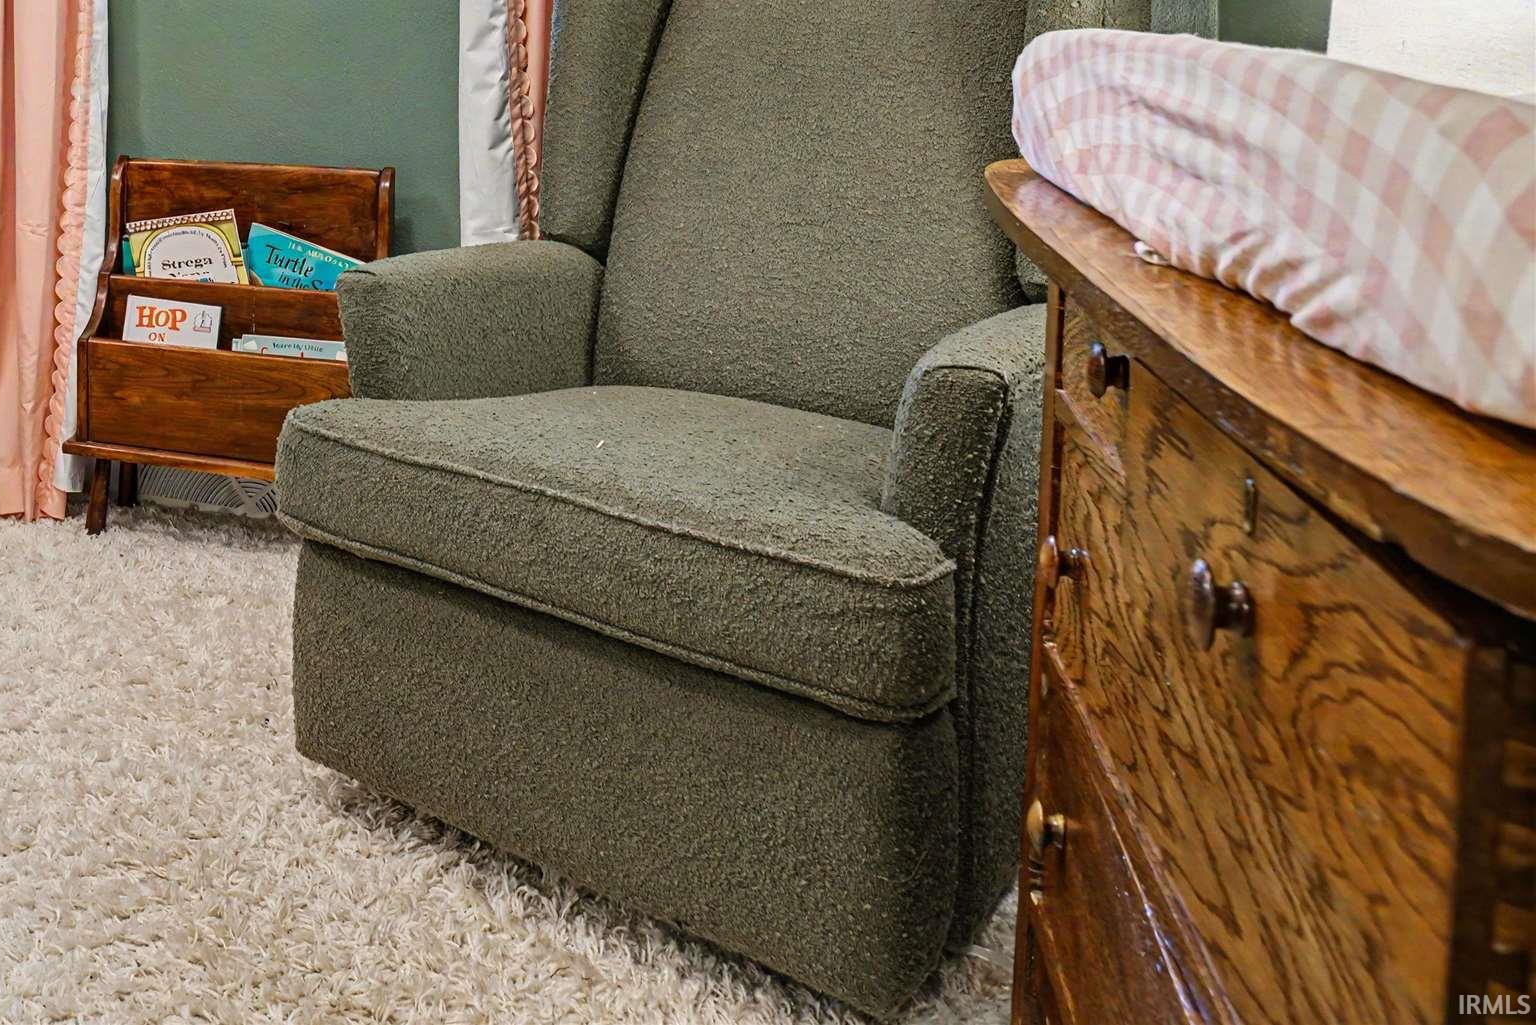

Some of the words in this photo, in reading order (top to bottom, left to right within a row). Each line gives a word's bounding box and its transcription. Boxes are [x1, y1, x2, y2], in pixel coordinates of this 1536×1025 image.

[161, 256, 213, 271] Strega
[265, 244, 314, 278] Turtle
[278, 272, 289, 285] in
[135, 304, 188, 331] HOP
[148, 332, 166, 342] ON
